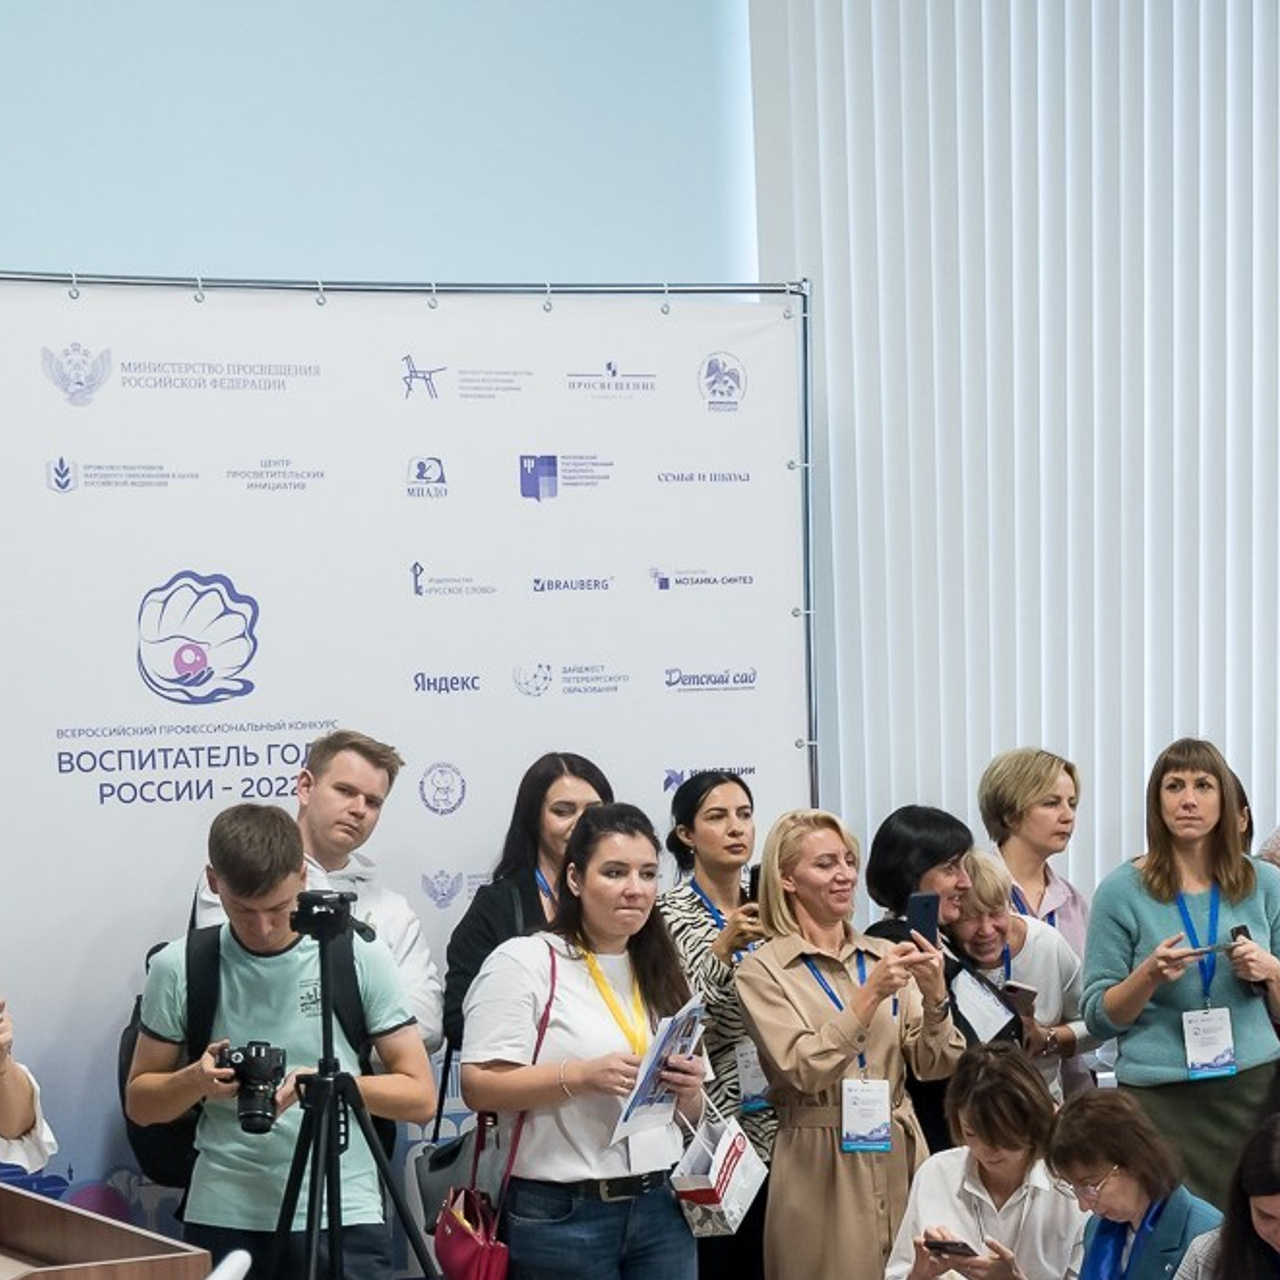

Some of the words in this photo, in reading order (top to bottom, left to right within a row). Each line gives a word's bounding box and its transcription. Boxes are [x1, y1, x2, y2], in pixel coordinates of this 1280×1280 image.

[260, 459, 292, 468] ЦЕНТР
[547, 579, 608, 590] BRAUBERG
[414, 673, 480, 694] Яндекс
[56, 724, 156, 739] ВСЕРОССИЙСКИЙ
[159, 720, 286, 735] ПРОФЕССИОНАЛЬНЫЙ
[287, 719, 339, 731] КОНКУРС
[58, 745, 259, 773] ВОСПИТАТЕЛЬ
[99, 779, 213, 805] РОССИИ
